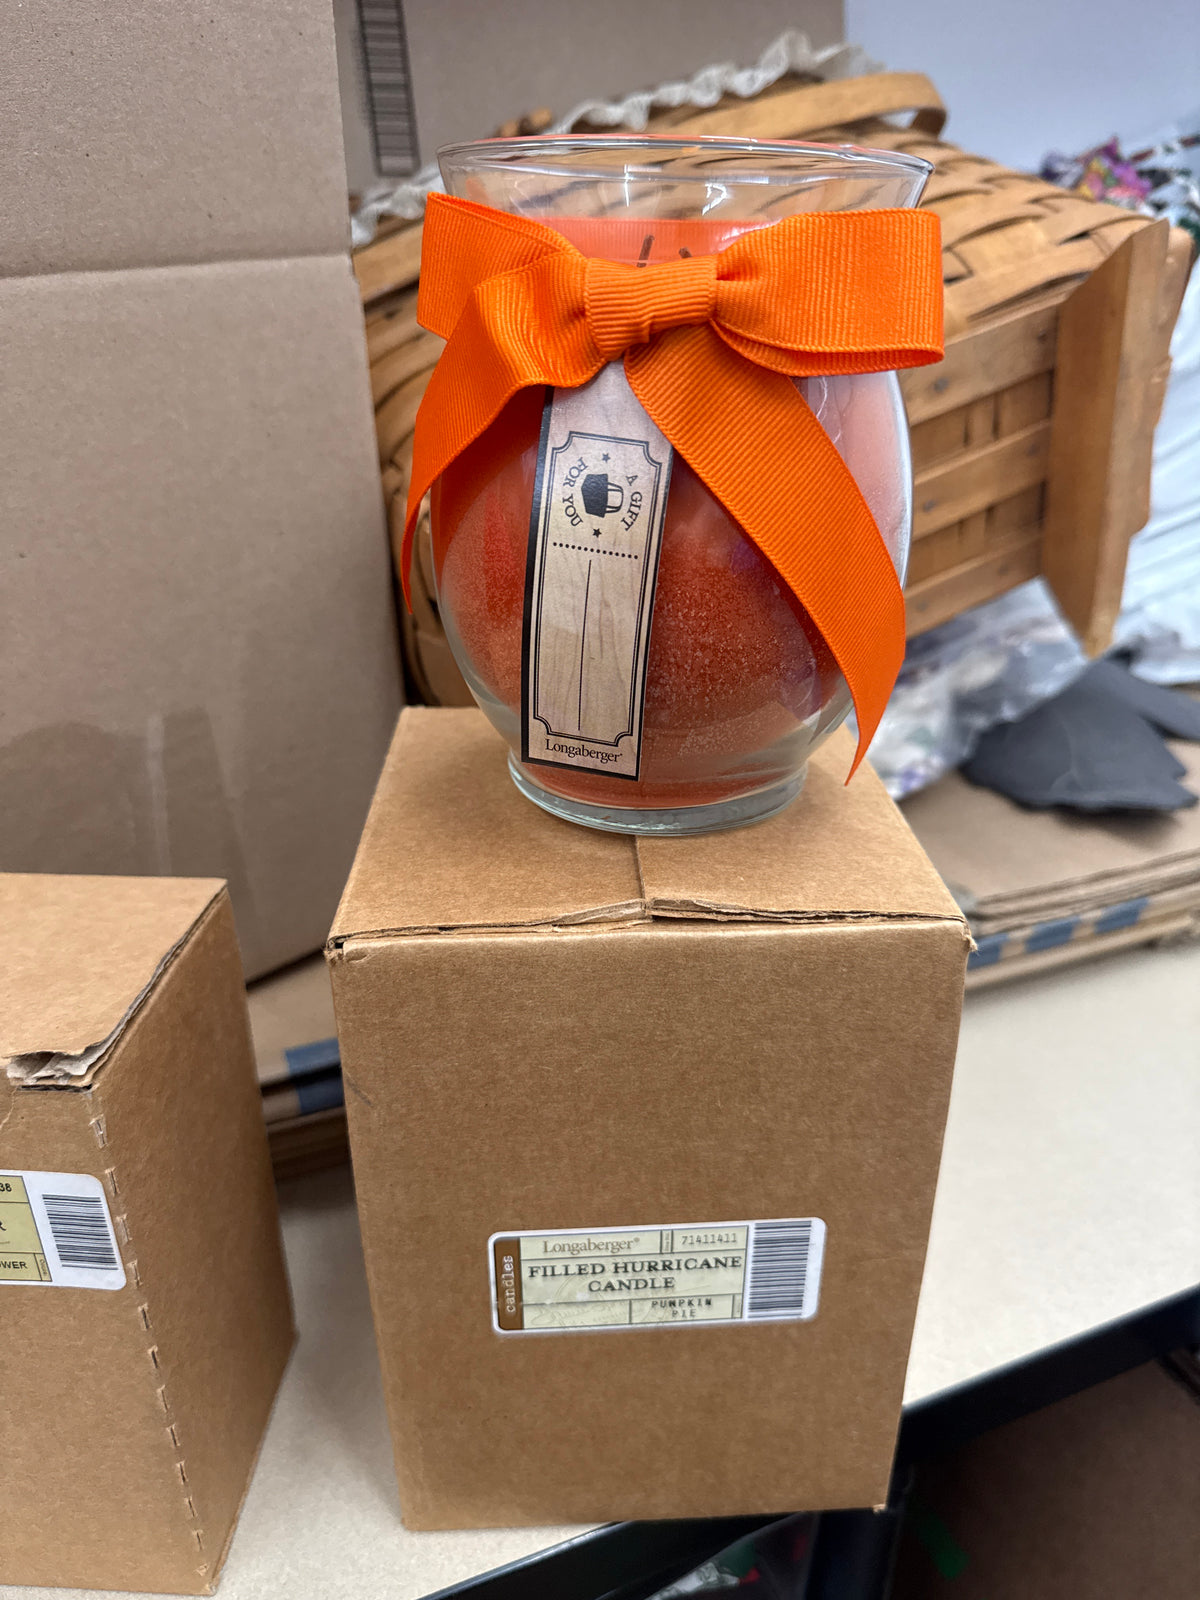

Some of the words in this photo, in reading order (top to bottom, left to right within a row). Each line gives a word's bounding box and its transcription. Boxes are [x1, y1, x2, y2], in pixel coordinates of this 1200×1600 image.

[562, 456, 589, 488] FOR
[625, 474, 639, 487] A
[562, 493, 584, 527] YOU
[620, 491, 643, 532] GIFT
[545, 738, 623, 764] Longaberger
[681, 1232, 738, 1246] 71411411
[528, 1262, 606, 1278] FILLED
[612, 1255, 742, 1274] HURRICANE
[502, 1255, 516, 1313] candles
[588, 1276, 676, 1293] CANDLE
[651, 1298, 713, 1309] PUMPKIN
[671, 1308, 697, 1318] PIE
